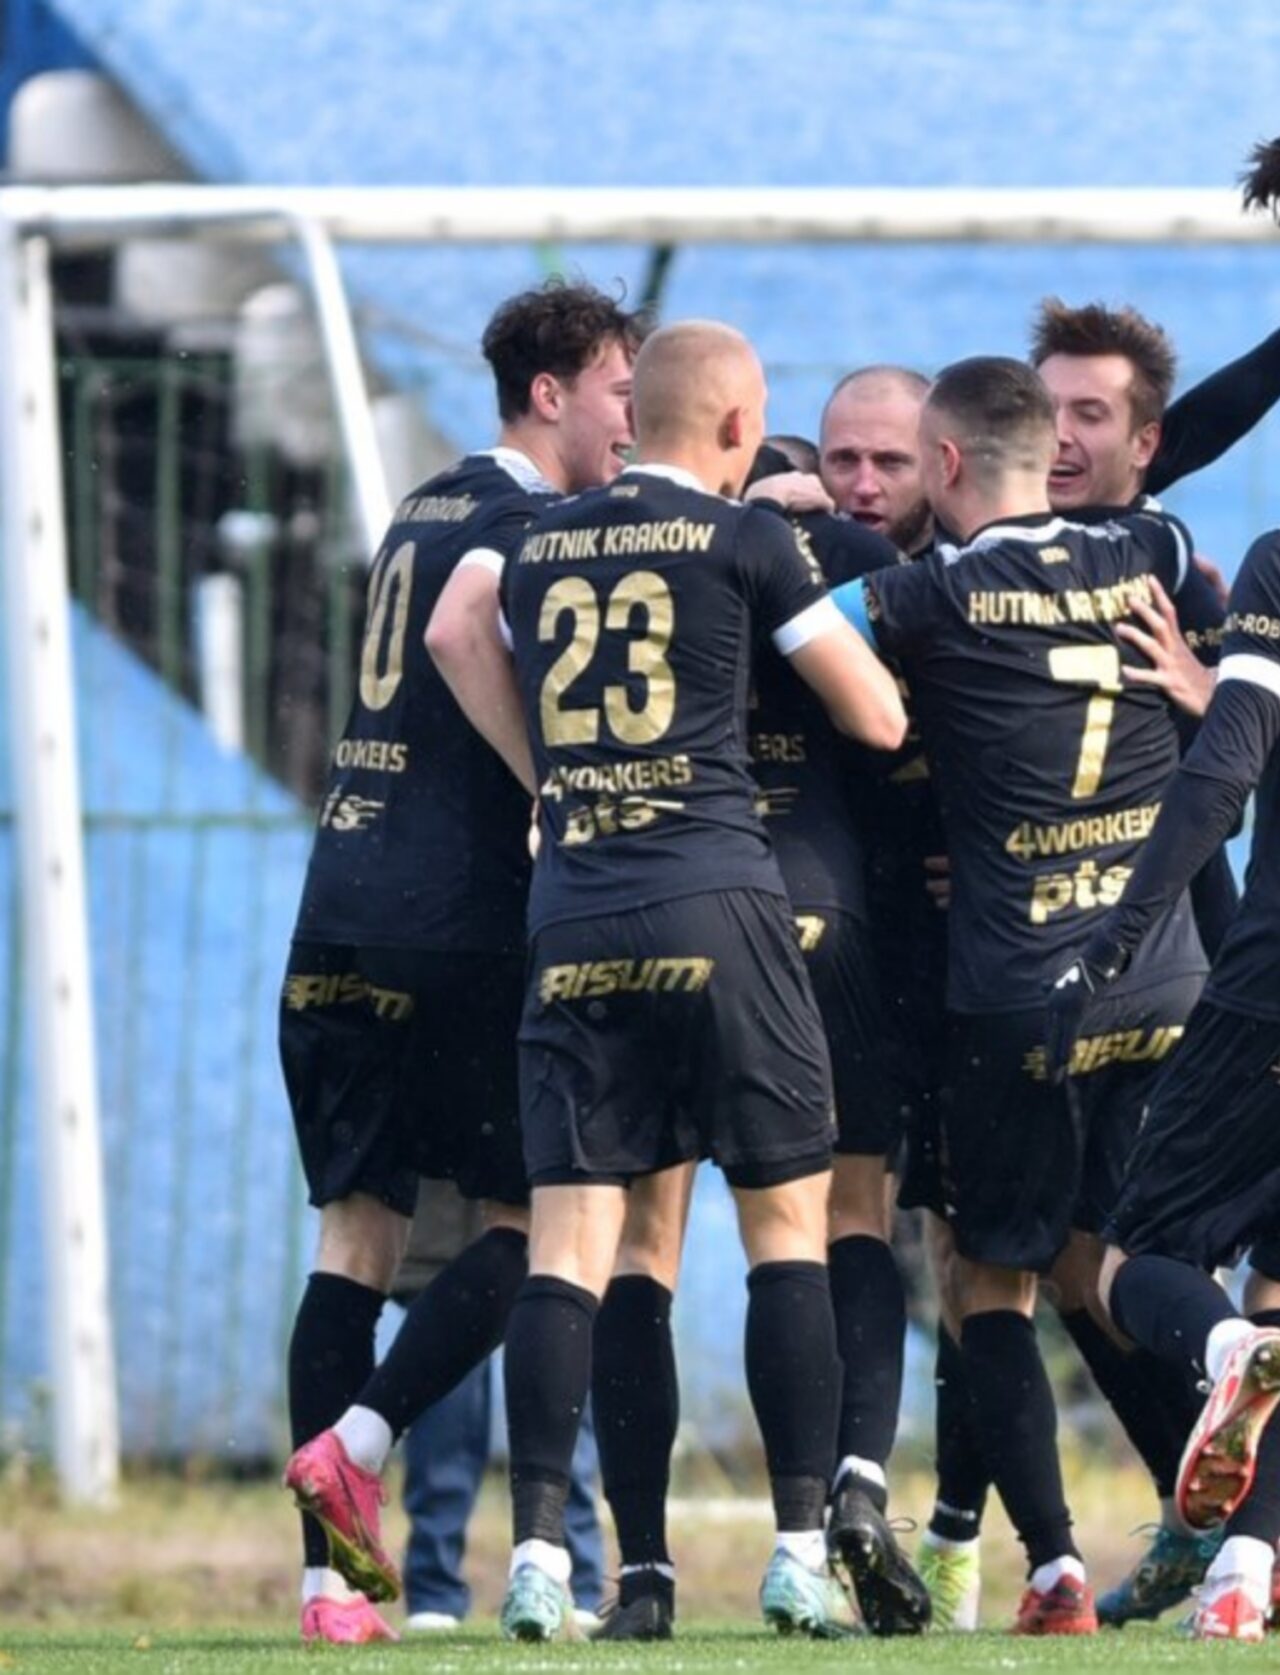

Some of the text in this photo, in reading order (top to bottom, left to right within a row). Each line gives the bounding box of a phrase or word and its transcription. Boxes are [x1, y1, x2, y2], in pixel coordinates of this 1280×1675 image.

[519, 516, 715, 564] HUTNIK KRAKÓW
[536, 570, 677, 748] 23
[1049, 645, 1122, 799] 7
[1006, 802, 1162, 860] 4WORKER
